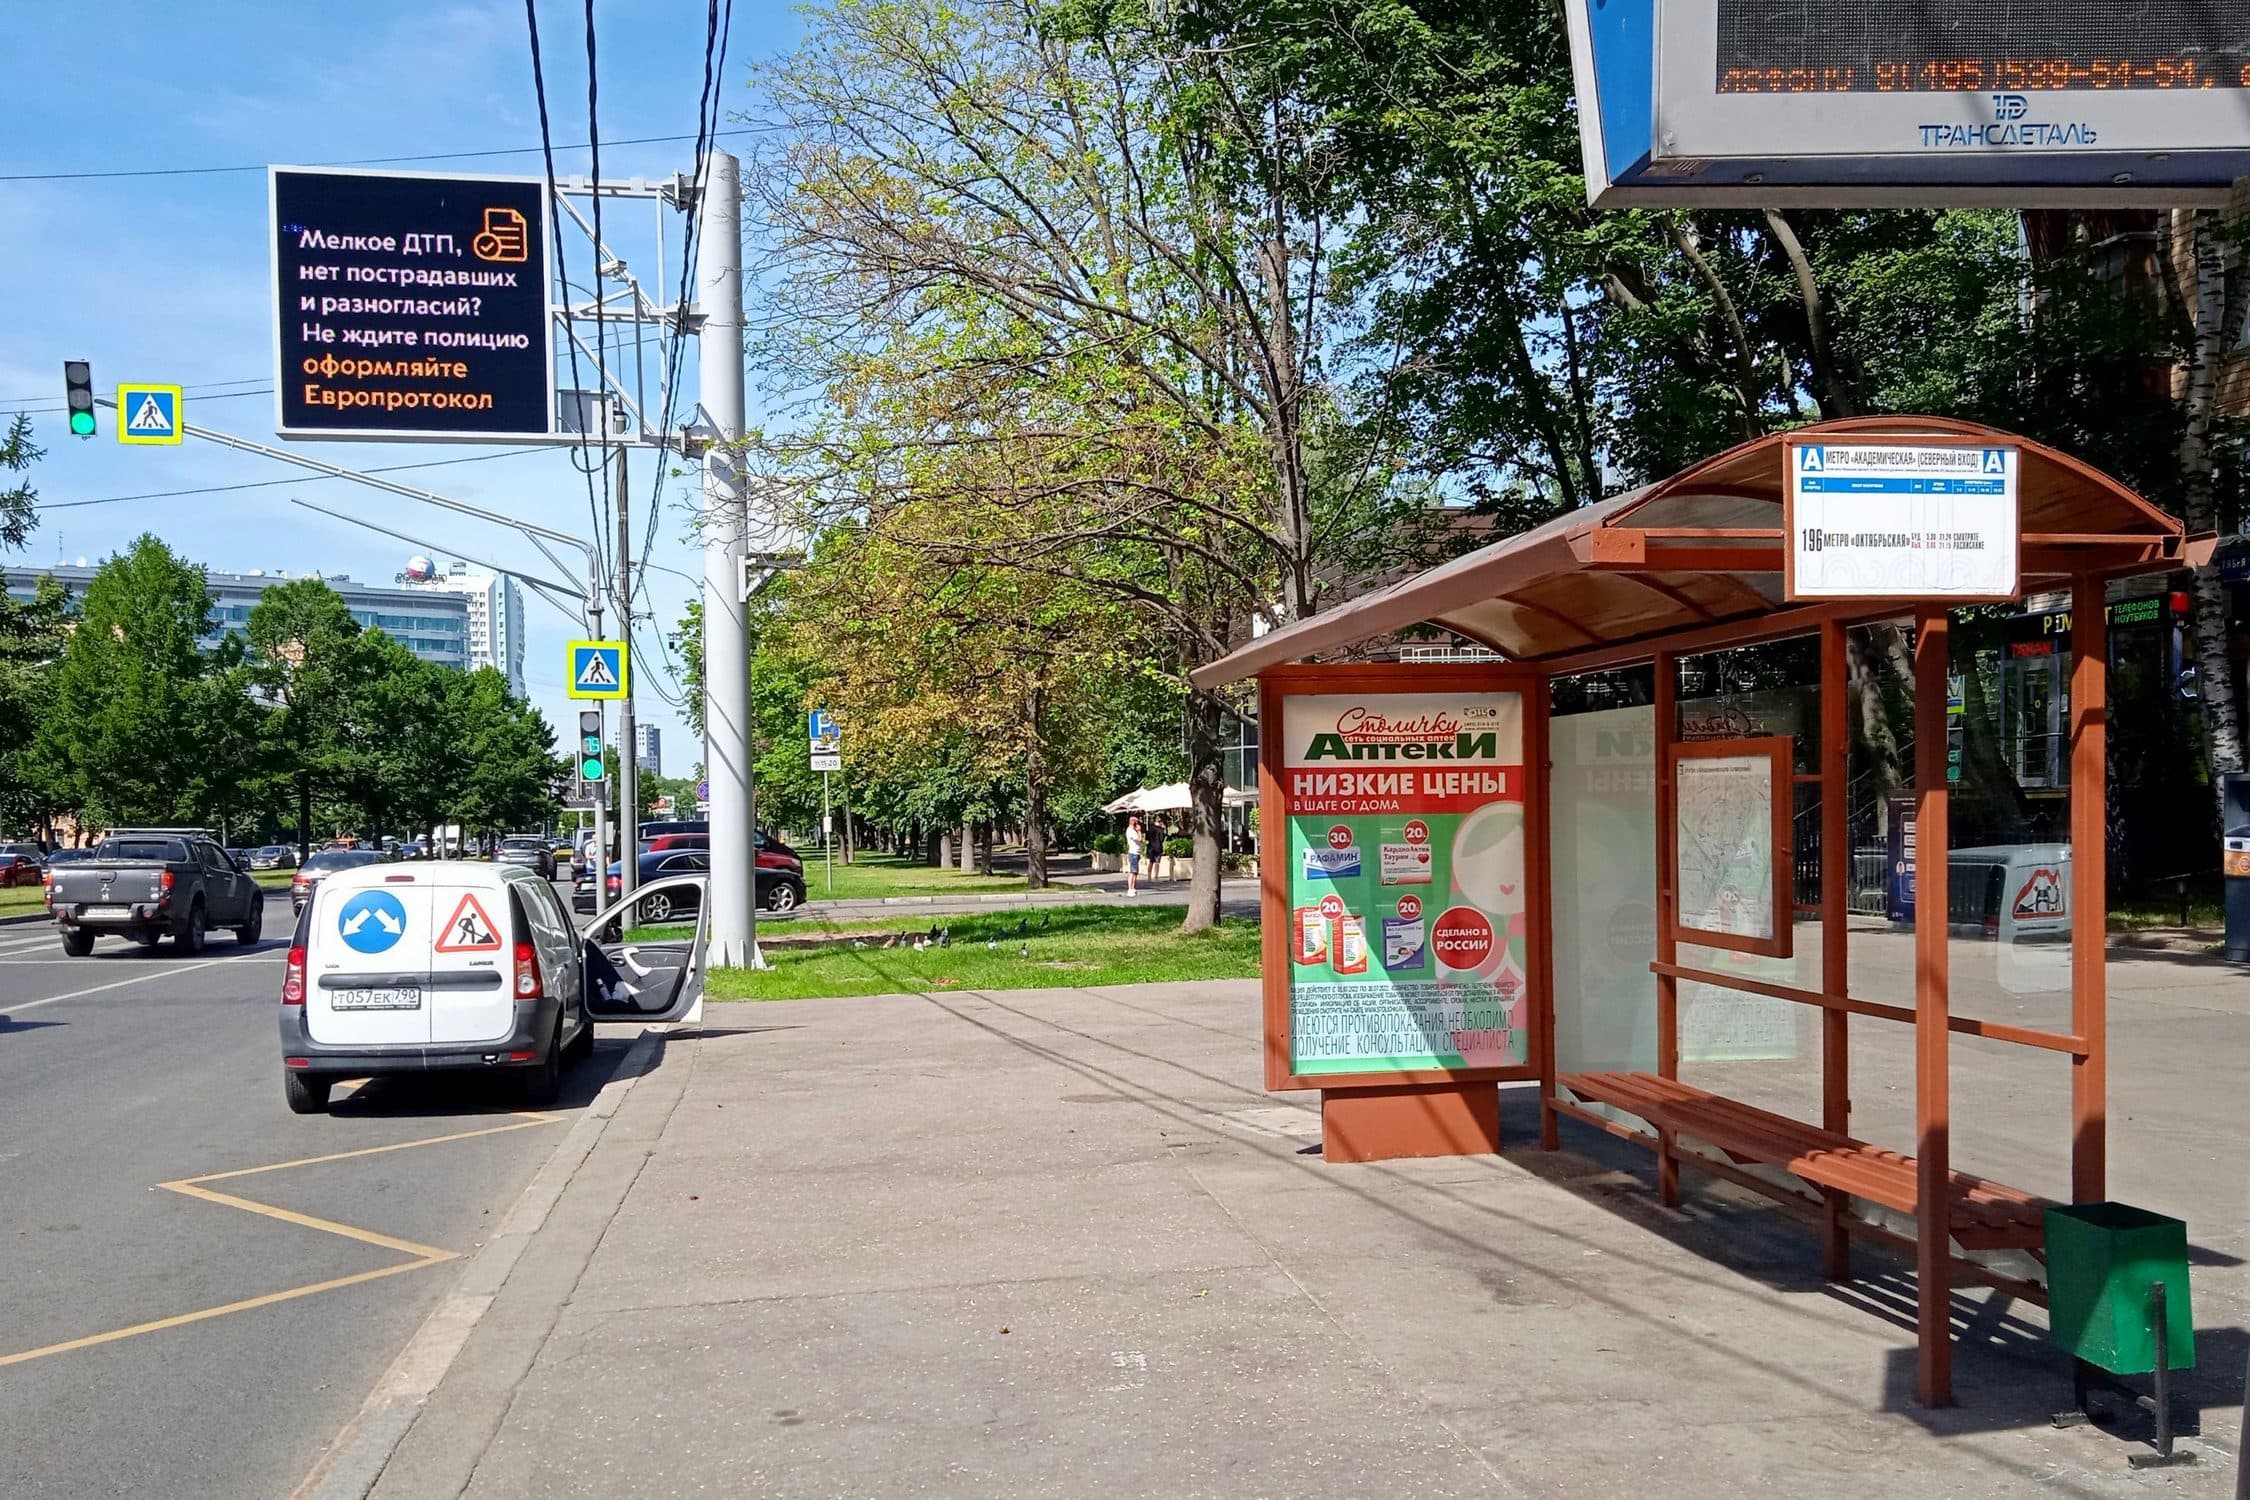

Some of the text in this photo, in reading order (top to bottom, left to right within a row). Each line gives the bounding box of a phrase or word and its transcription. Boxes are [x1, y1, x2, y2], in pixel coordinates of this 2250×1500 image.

[1918, 123, 2097, 147] ТРАНСДЕТАЛЬ
[299, 229, 463, 258] Мелкое ДТП,
[299, 266, 518, 288] нет пострадавших
[300, 296, 482, 316] и разногласий?
[302, 323, 529, 350] Не ждите полицию
[303, 353, 469, 379] оформляйте
[304, 384, 493, 411] Европротокол
[1826, 451, 1849, 464] МЕТРО
[1851, 451, 1916, 466] «АКАДЕМИЧЕСКАЯ»
[1918, 450, 1956, 467] (СЕВЕРНЫЙ
[1957, 453, 1979, 469] ВХОД)
[1802, 528, 1822, 551] 196
[1824, 533, 1849, 547] МЕТРО
[1851, 533, 1910, 547] «ОКТЯБРЬСКАЯ»
[2114, 599, 2160, 614] ТЕЛЕФОНОВ
[2114, 610, 2159, 624] НОУТБУКОВ
[1336, 707, 1463, 736] Столички
[1366, 735, 1425, 743] социальных
[1293, 772, 1506, 798] НИЗКИЕ ЦЕНЫ
[1294, 800, 1399, 811] В ШАГЕ ОТ ДОМА
[1310, 852, 1357, 863] РАФАМИН
[1436, 928, 1488, 937] СДЕЛАНО В
[1436, 940, 1488, 950] РОССИИ
[1291, 1010, 1513, 1035] ИМЕЮТСЯ ПРОТИВОПОКАЗАНИЯ. НЕОБХОДИМО
[1292, 1030, 1515, 1056] ПОЛУЧЕНИЕ КОНСУЛЬТАЦИИ СПЕЦИАЛИСТА
